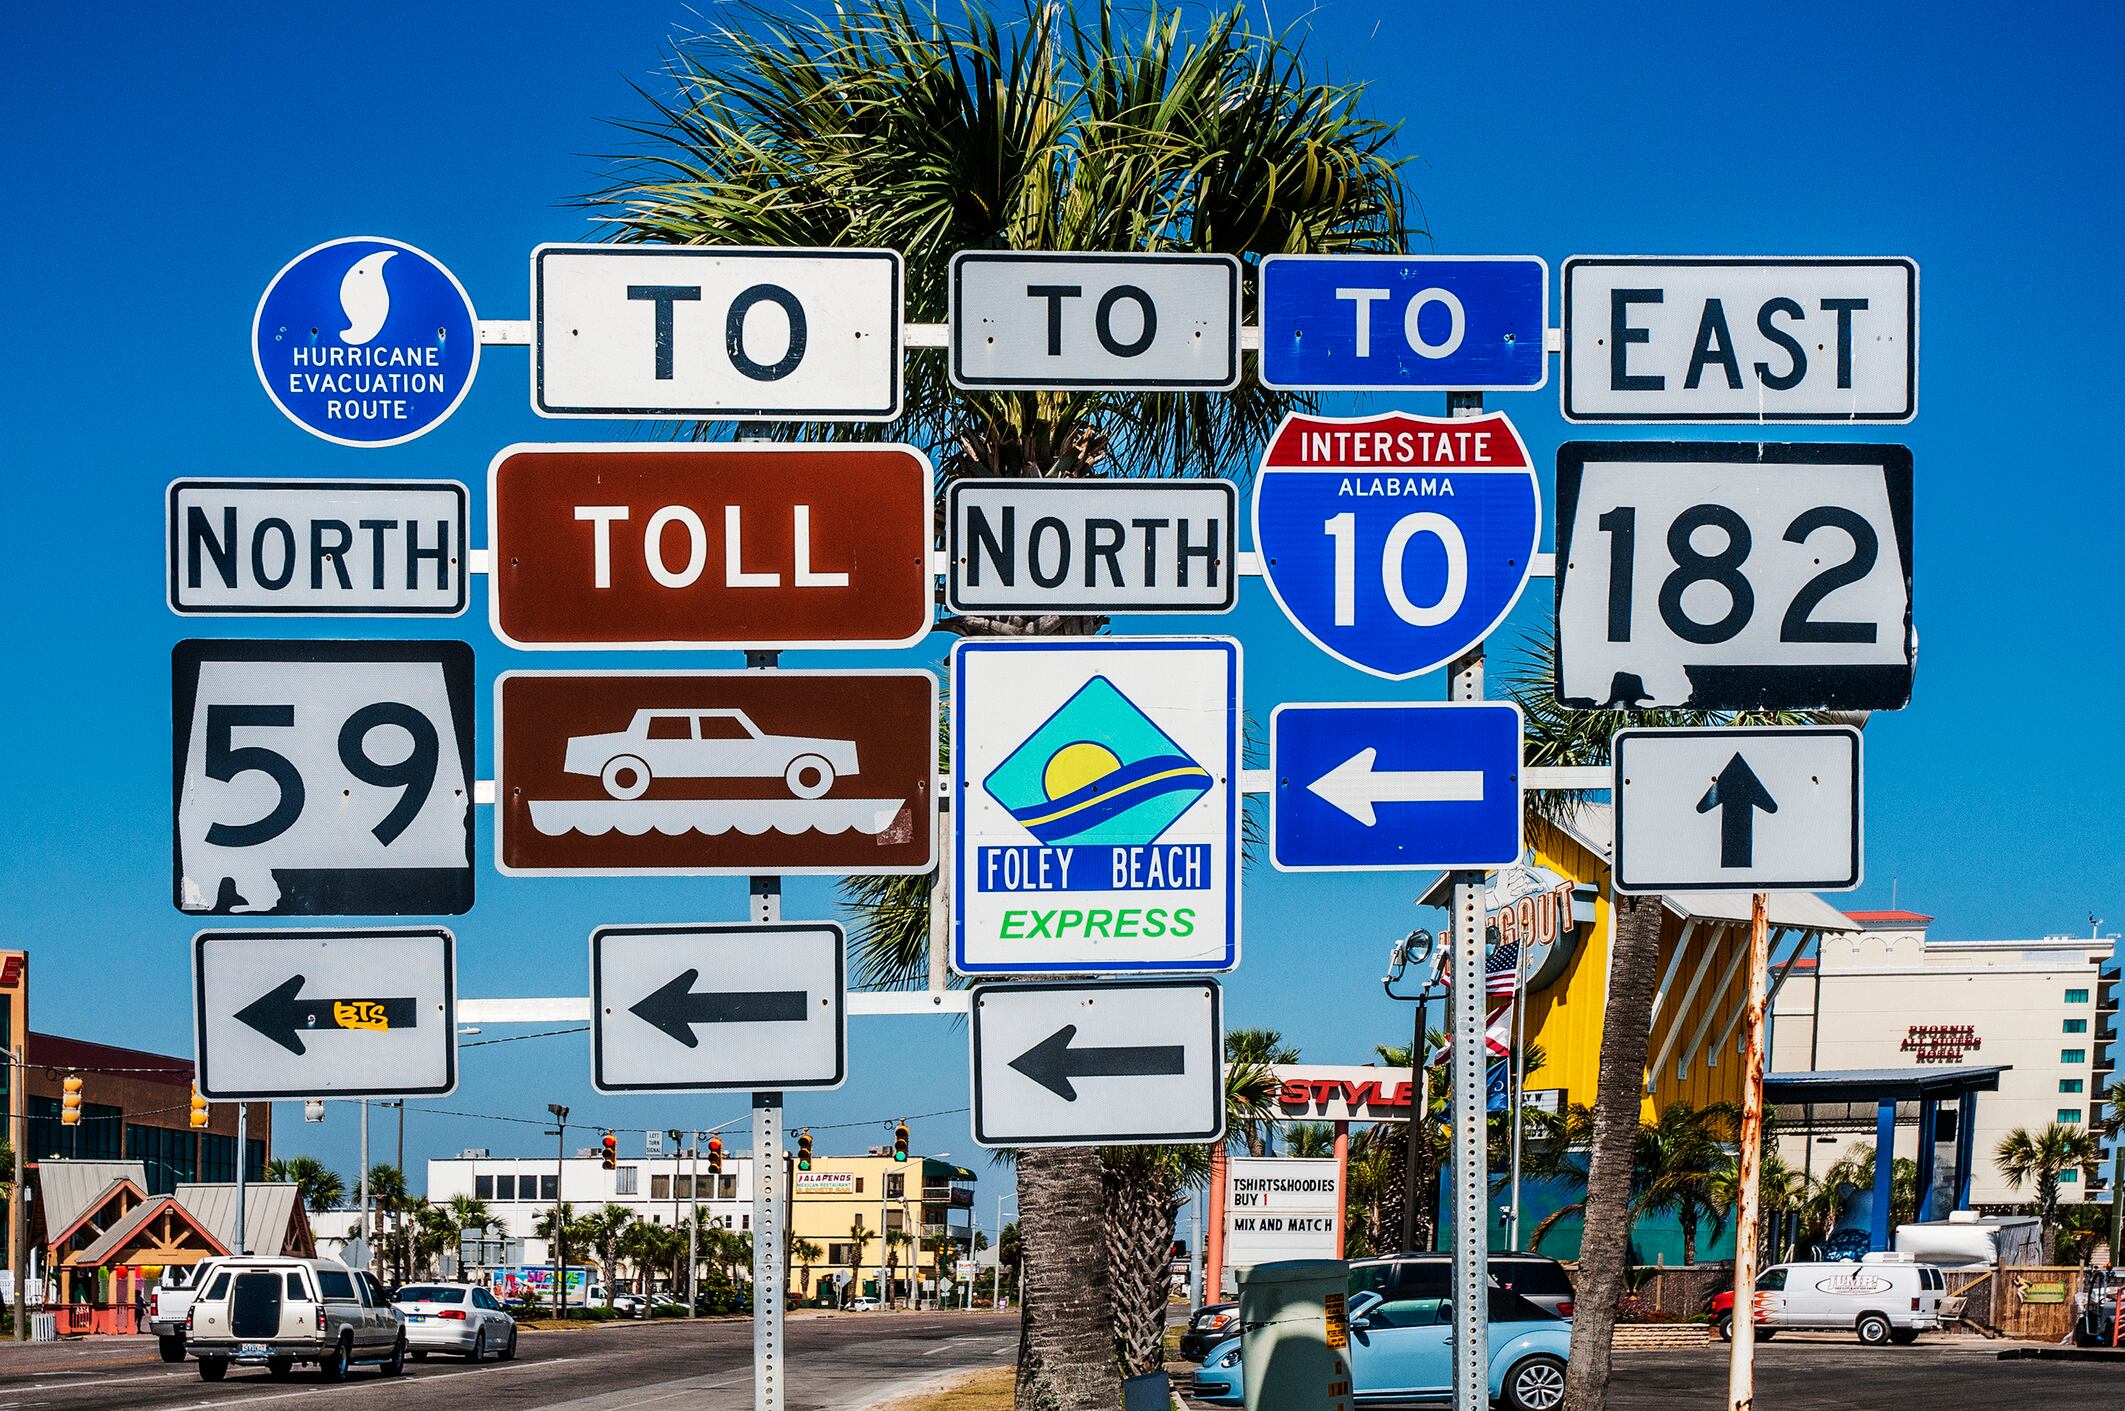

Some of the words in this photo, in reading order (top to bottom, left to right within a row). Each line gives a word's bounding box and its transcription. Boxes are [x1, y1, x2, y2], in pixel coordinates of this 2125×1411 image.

[626, 283, 808, 382] TO
[1026, 284, 1158, 358] TO
[1335, 287, 1466, 359] TO
[1610, 287, 1869, 392] EAST
[293, 347, 439, 367] HURRICANE
[289, 373, 445, 393] EVACUATION
[327, 400, 408, 419] ROUTE
[1300, 431, 1493, 463] INTERSTATE
[1338, 477, 1455, 497] ALABAMA
[187, 505, 449, 591] NORTH
[574, 504, 850, 589] TOLL
[966, 505, 1218, 590] NORTH
[1323, 511, 1468, 628] 10
[1598, 503, 1879, 645] 182
[204, 701, 440, 848] 59
[986, 847, 1074, 890] FOLEY
[1112, 846, 1202, 889] BEACH
[999, 907, 1196, 940] EXPRESS
[334, 1001, 388, 1032] BTS
[1908, 1025, 1976, 1036] PHOENIX
[1279, 1079, 1420, 1107] STYLE
[1234, 1179, 1335, 1192] TSHIRTS&HOODIES
[1235, 1193, 1258, 1206] BUY
[1263, 1193, 1268, 1206] 1
[1235, 1219, 1256, 1231] MIX
[1259, 1219, 1283, 1231] AND
[1288, 1219, 1332, 1231] MATCH
